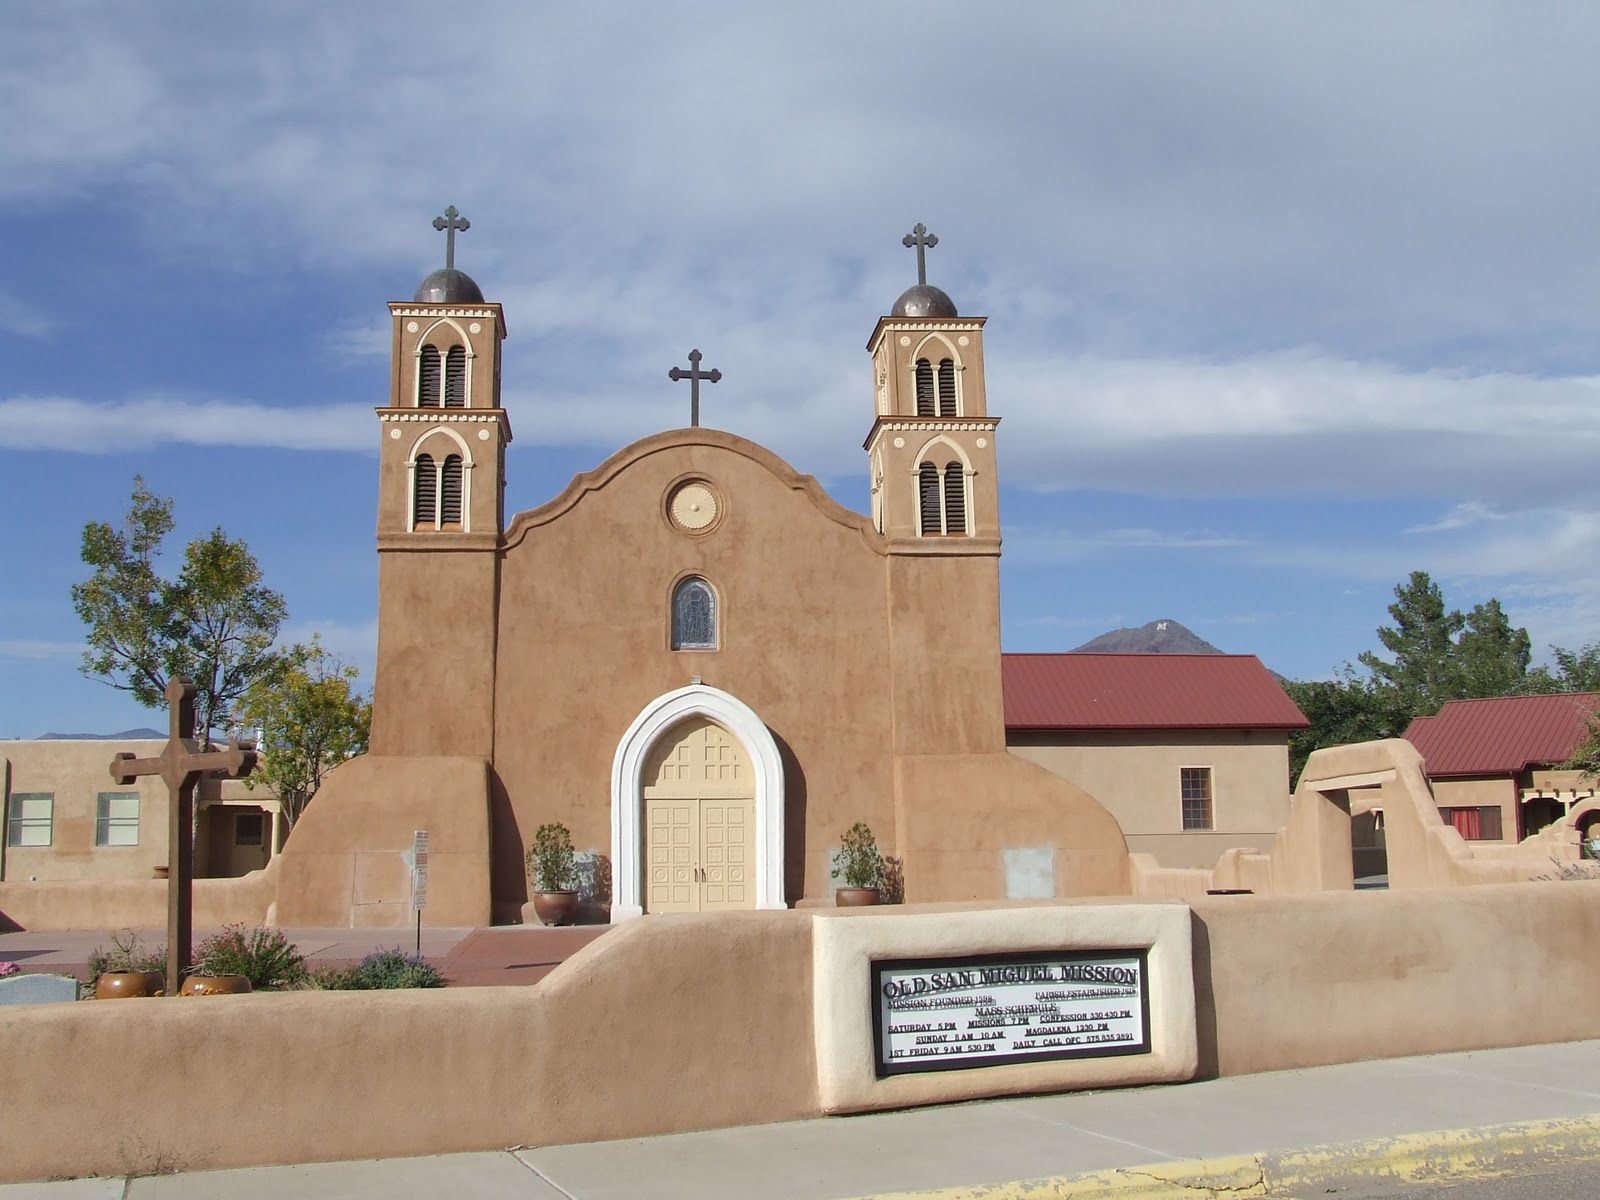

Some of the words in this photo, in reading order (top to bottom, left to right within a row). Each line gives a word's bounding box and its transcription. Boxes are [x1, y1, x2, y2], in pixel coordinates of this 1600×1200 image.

[883, 977, 926, 999] OLD
[930, 970, 972, 991] SAN
[979, 965, 1053, 985] MIGUEL
[1060, 965, 1137, 984] MISSION
[1035, 990, 1065, 1000] PARISH
[1067, 987, 1120, 998] ESTABLISHED
[888, 999, 927, 1009] MISSION
[929, 996, 973, 1007] FOUNDED
[975, 995, 993, 1005] 1598
[975, 1006, 1003, 1016] MASS
[1005, 1003, 1057, 1014] SCHEDULE
[968, 1018, 1006, 1029] MISSIONS
[1011, 1017, 1017, 1025] 7
[1018, 1017, 1029, 1025] PM
[1040, 1012, 1087, 1023] CONFESSION
[1090, 1012, 1102, 1020] 330
[1104, 1011, 1118, 1019] 430
[1120, 1010, 1131, 1018] PM
[888, 1023, 932, 1034] SATURDAY
[938, 1023, 943, 1031] 5
[944, 1022, 956, 1031] PM
[1025, 1026, 1071, 1037] MAGDALENA
[1076, 1024, 1093, 1032] 1230
[1097, 1023, 1109, 1031] PM
[916, 1034, 948, 1044] SUNDAY
[961, 1033, 974, 1041] AM
[981, 1032, 989, 1040] 10
[992, 1031, 1005, 1039] AM
[1013, 1040, 1036, 1049] DAILY
[1043, 1038, 1062, 1047] CALL
[1065, 1036, 1081, 1045] OFC
[1086, 1035, 1100, 1044] 575
[1101, 1034, 1115, 1043] 835
[1116, 1032, 1133, 1041] 2891
[889, 1049, 904, 1058] 1ST
[909, 1047, 939, 1057] FRIDAY
[967, 1044, 982, 1053] 530
[983, 1043, 995, 1052] PM
